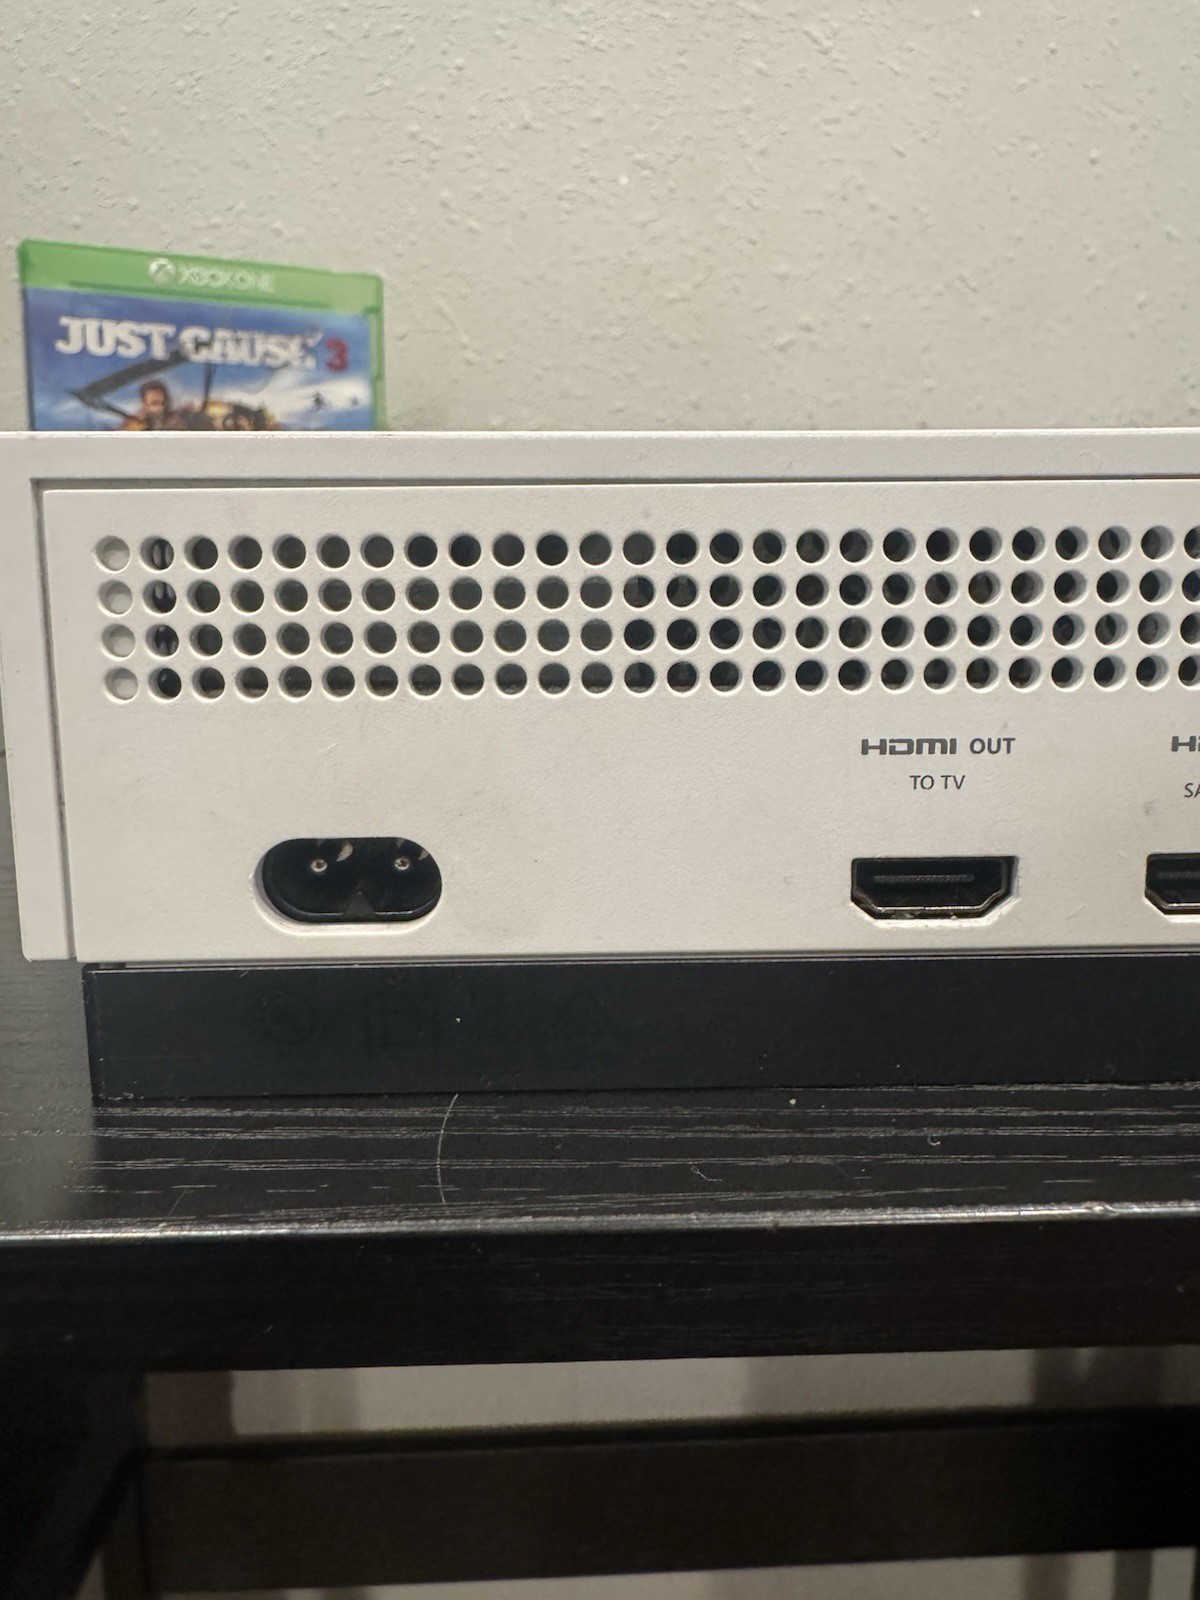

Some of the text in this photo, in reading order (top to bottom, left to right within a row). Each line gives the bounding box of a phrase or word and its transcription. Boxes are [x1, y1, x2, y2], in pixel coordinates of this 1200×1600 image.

[56, 315, 349, 372] JUST CAUSE 3
[861, 737, 1016, 755] HDMI OUT
[910, 774, 966, 790] TO TV
